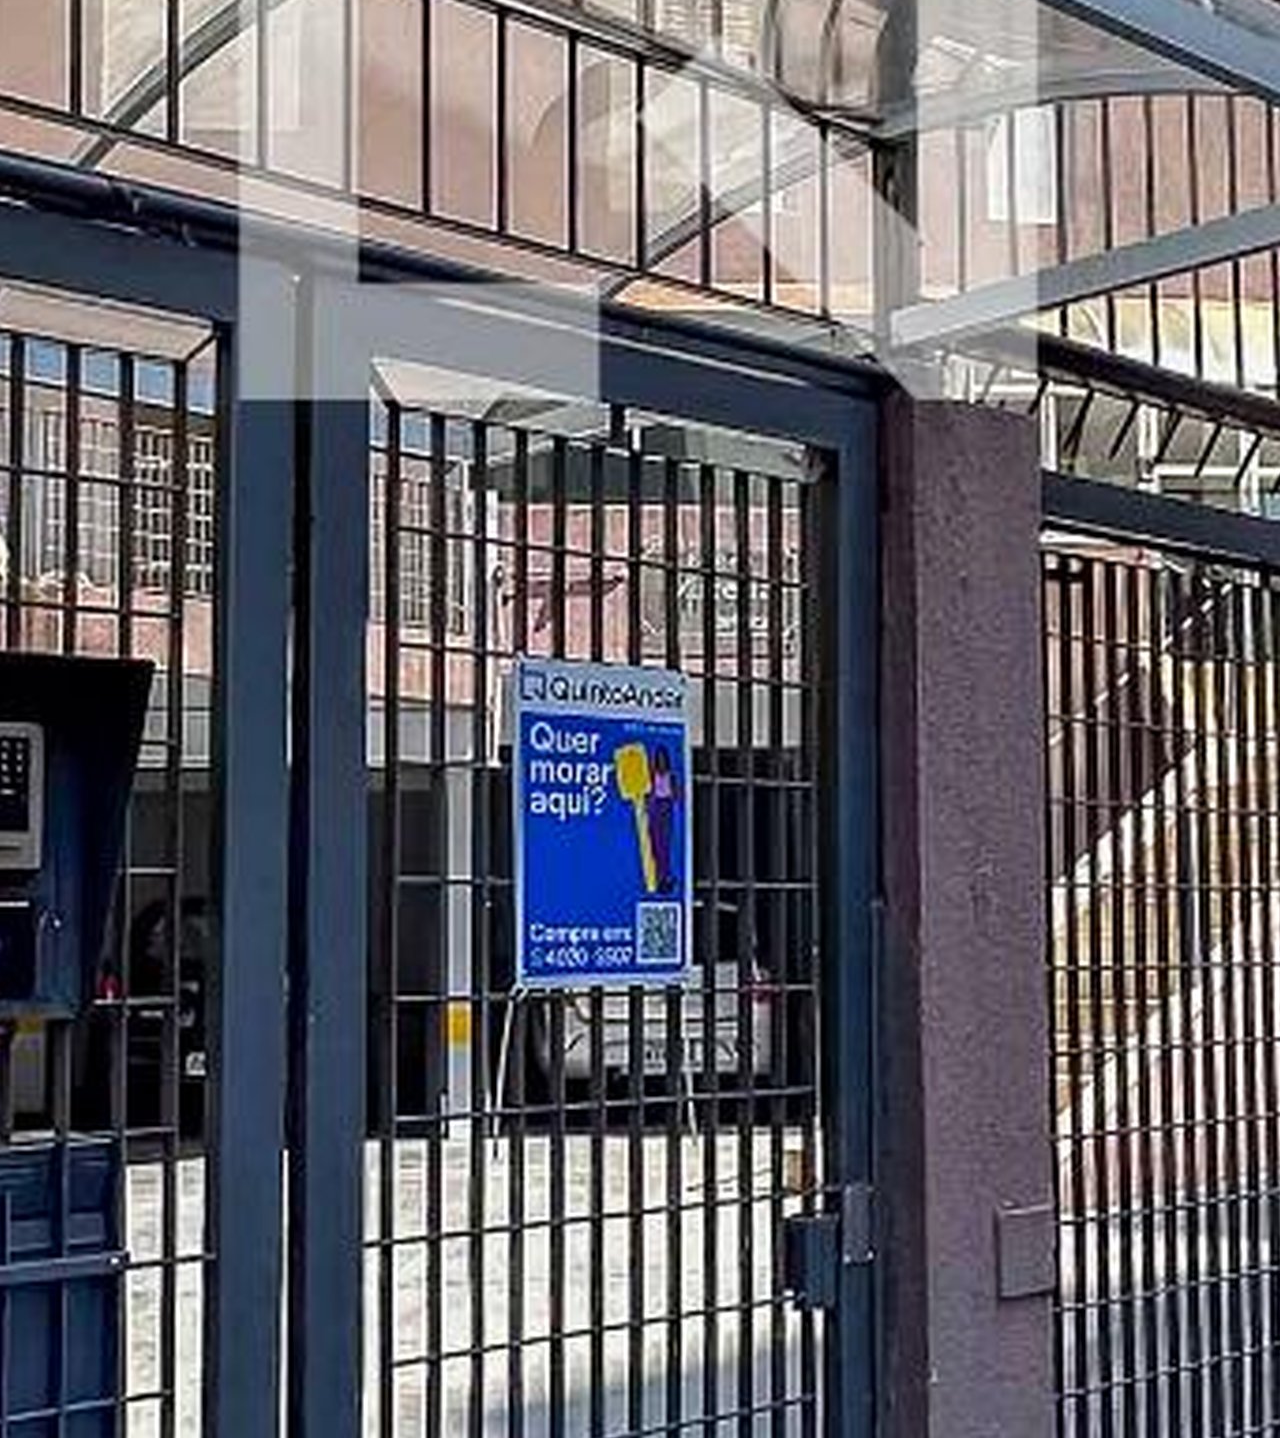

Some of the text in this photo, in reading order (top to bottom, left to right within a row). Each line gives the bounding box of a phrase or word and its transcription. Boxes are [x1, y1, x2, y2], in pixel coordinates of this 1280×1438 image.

[550, 676, 682, 709] QuintoAndar
[530, 721, 600, 755] Quer
[530, 758, 613, 785] morar
[530, 785, 607, 821] aqui?
